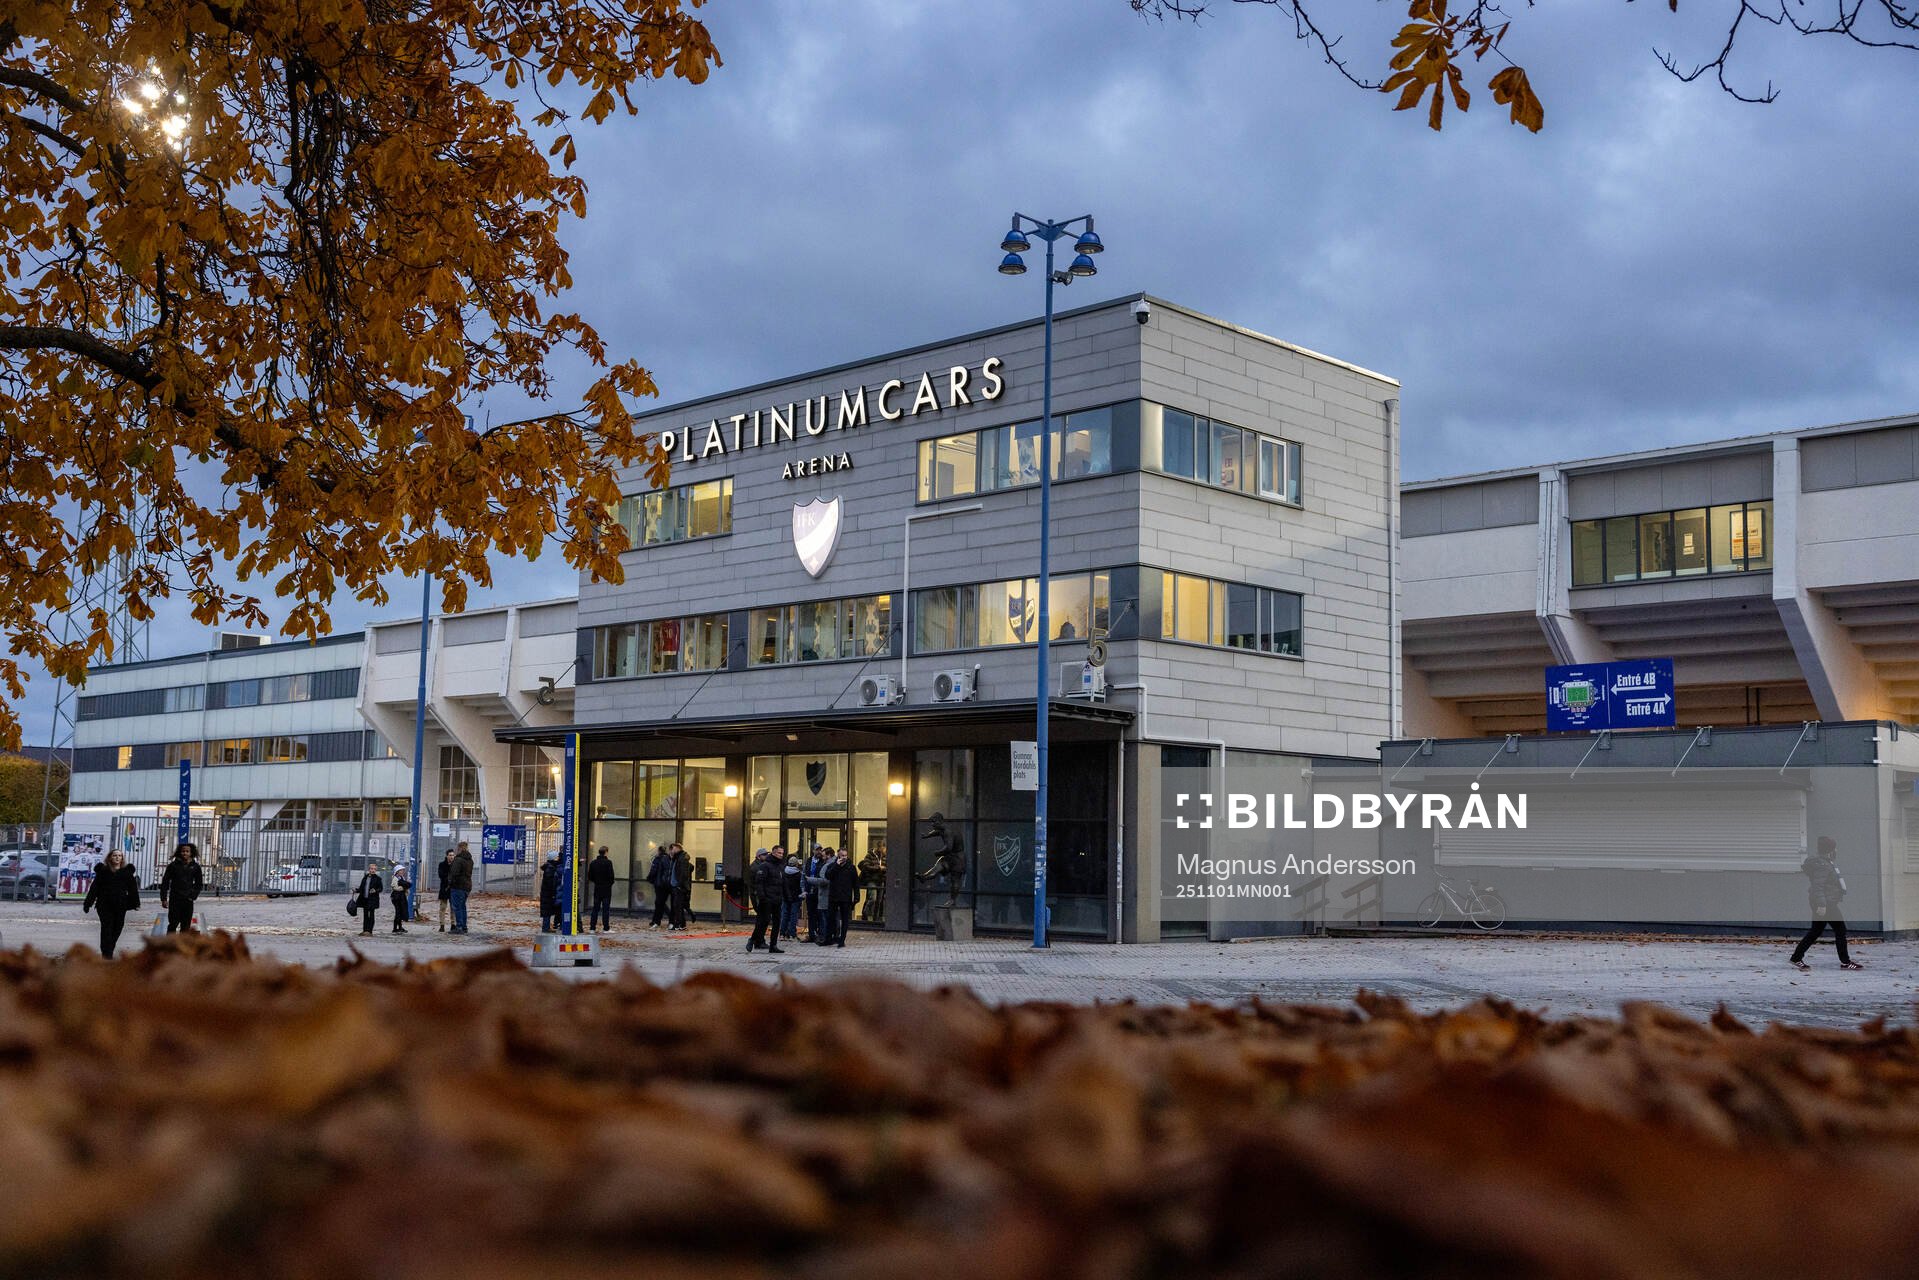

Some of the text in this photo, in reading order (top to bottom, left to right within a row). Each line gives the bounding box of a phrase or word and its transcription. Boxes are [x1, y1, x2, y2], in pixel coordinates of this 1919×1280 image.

[661, 357, 1004, 462] PLATINUMCARS
[782, 451, 853, 480] ARENA
[797, 512, 816, 528] IFK
[1089, 627, 1108, 667] 5
[1616, 672, 1657, 687] Entré 4B
[1626, 701, 1666, 717] Entré 4A
[1013, 770, 1026, 781] plats
